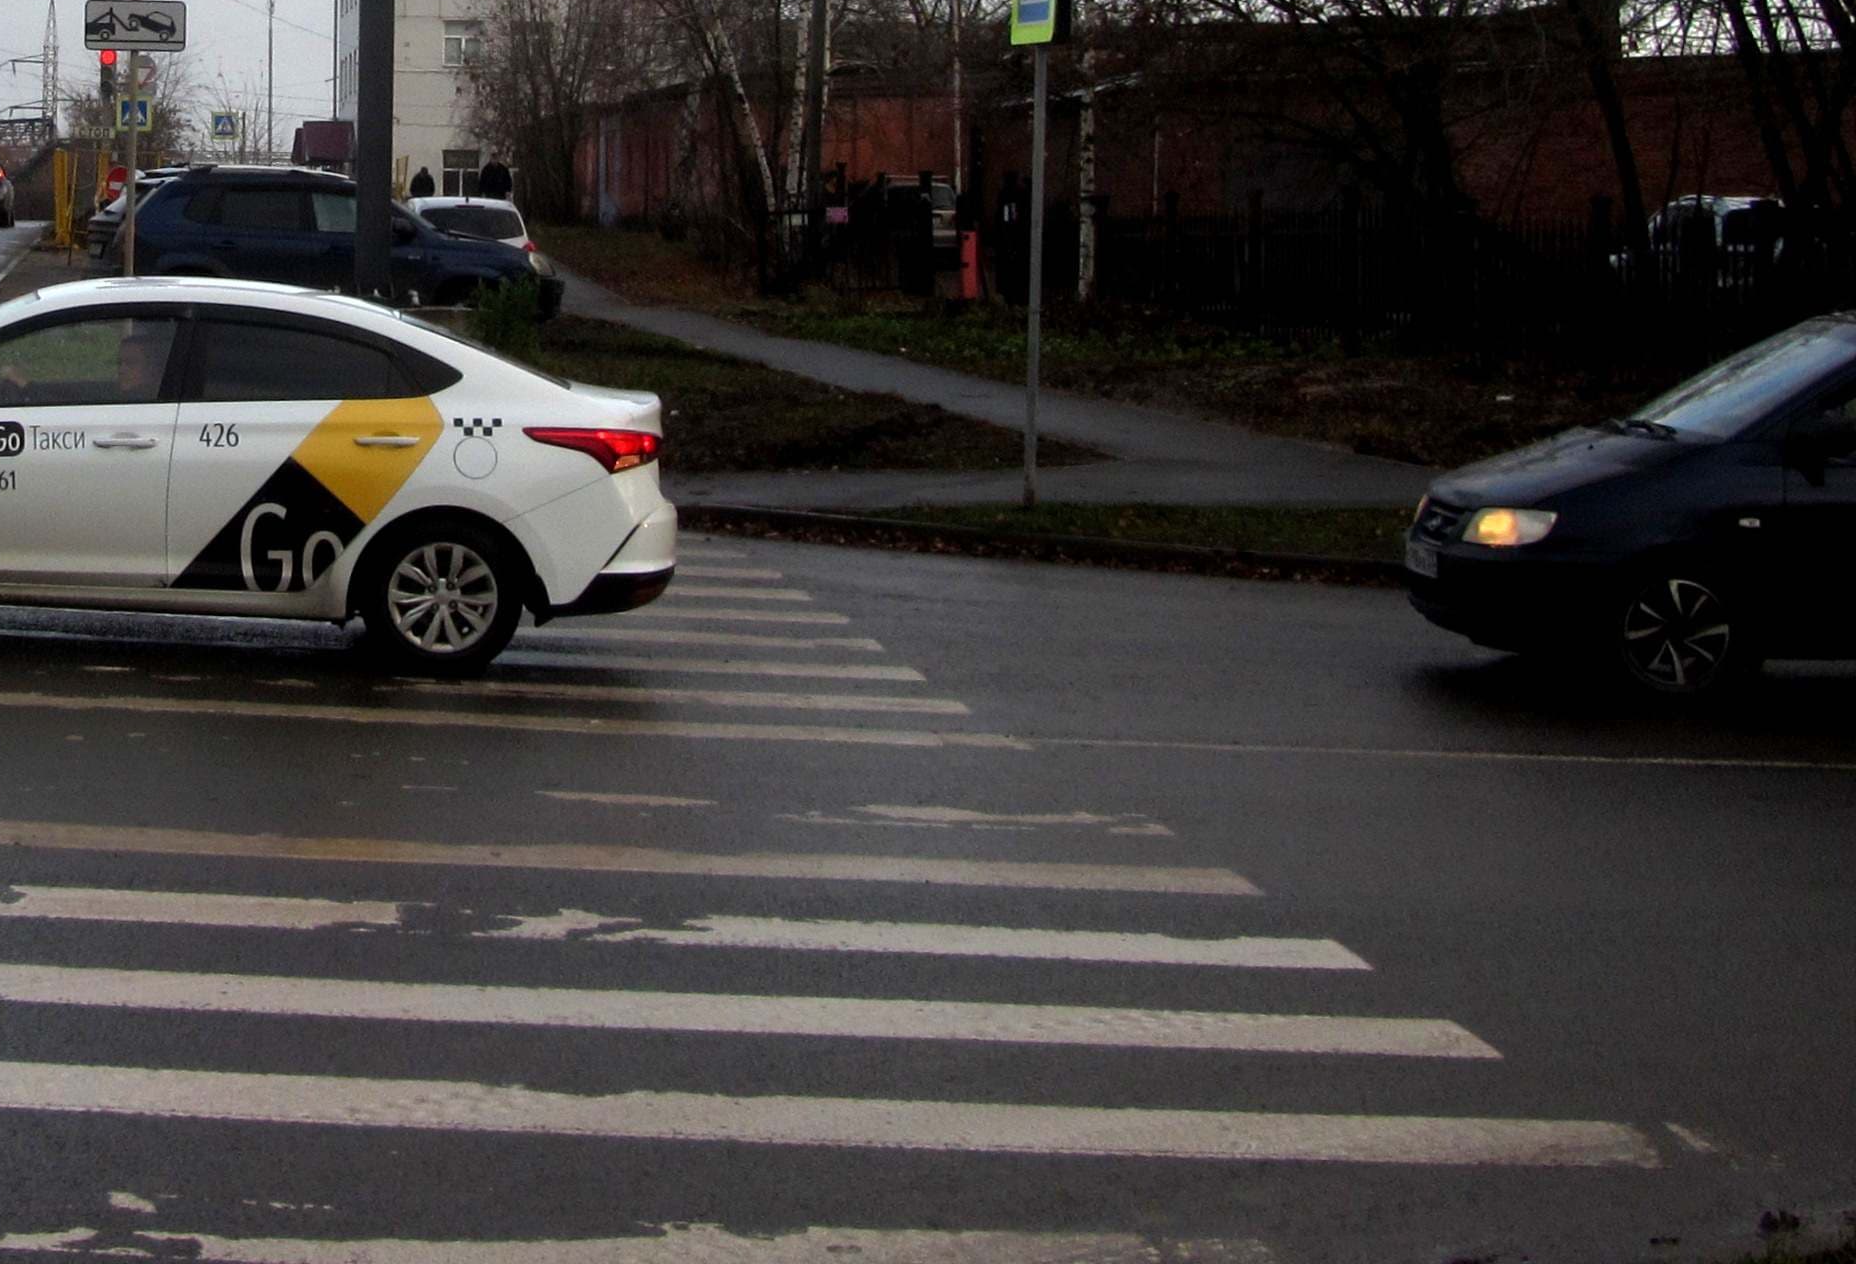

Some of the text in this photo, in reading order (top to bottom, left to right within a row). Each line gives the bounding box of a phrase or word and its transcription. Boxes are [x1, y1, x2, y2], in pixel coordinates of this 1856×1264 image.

[29, 425, 86, 451] Такси
[199, 423, 240, 448] 426
[240, 502, 345, 592] Go
